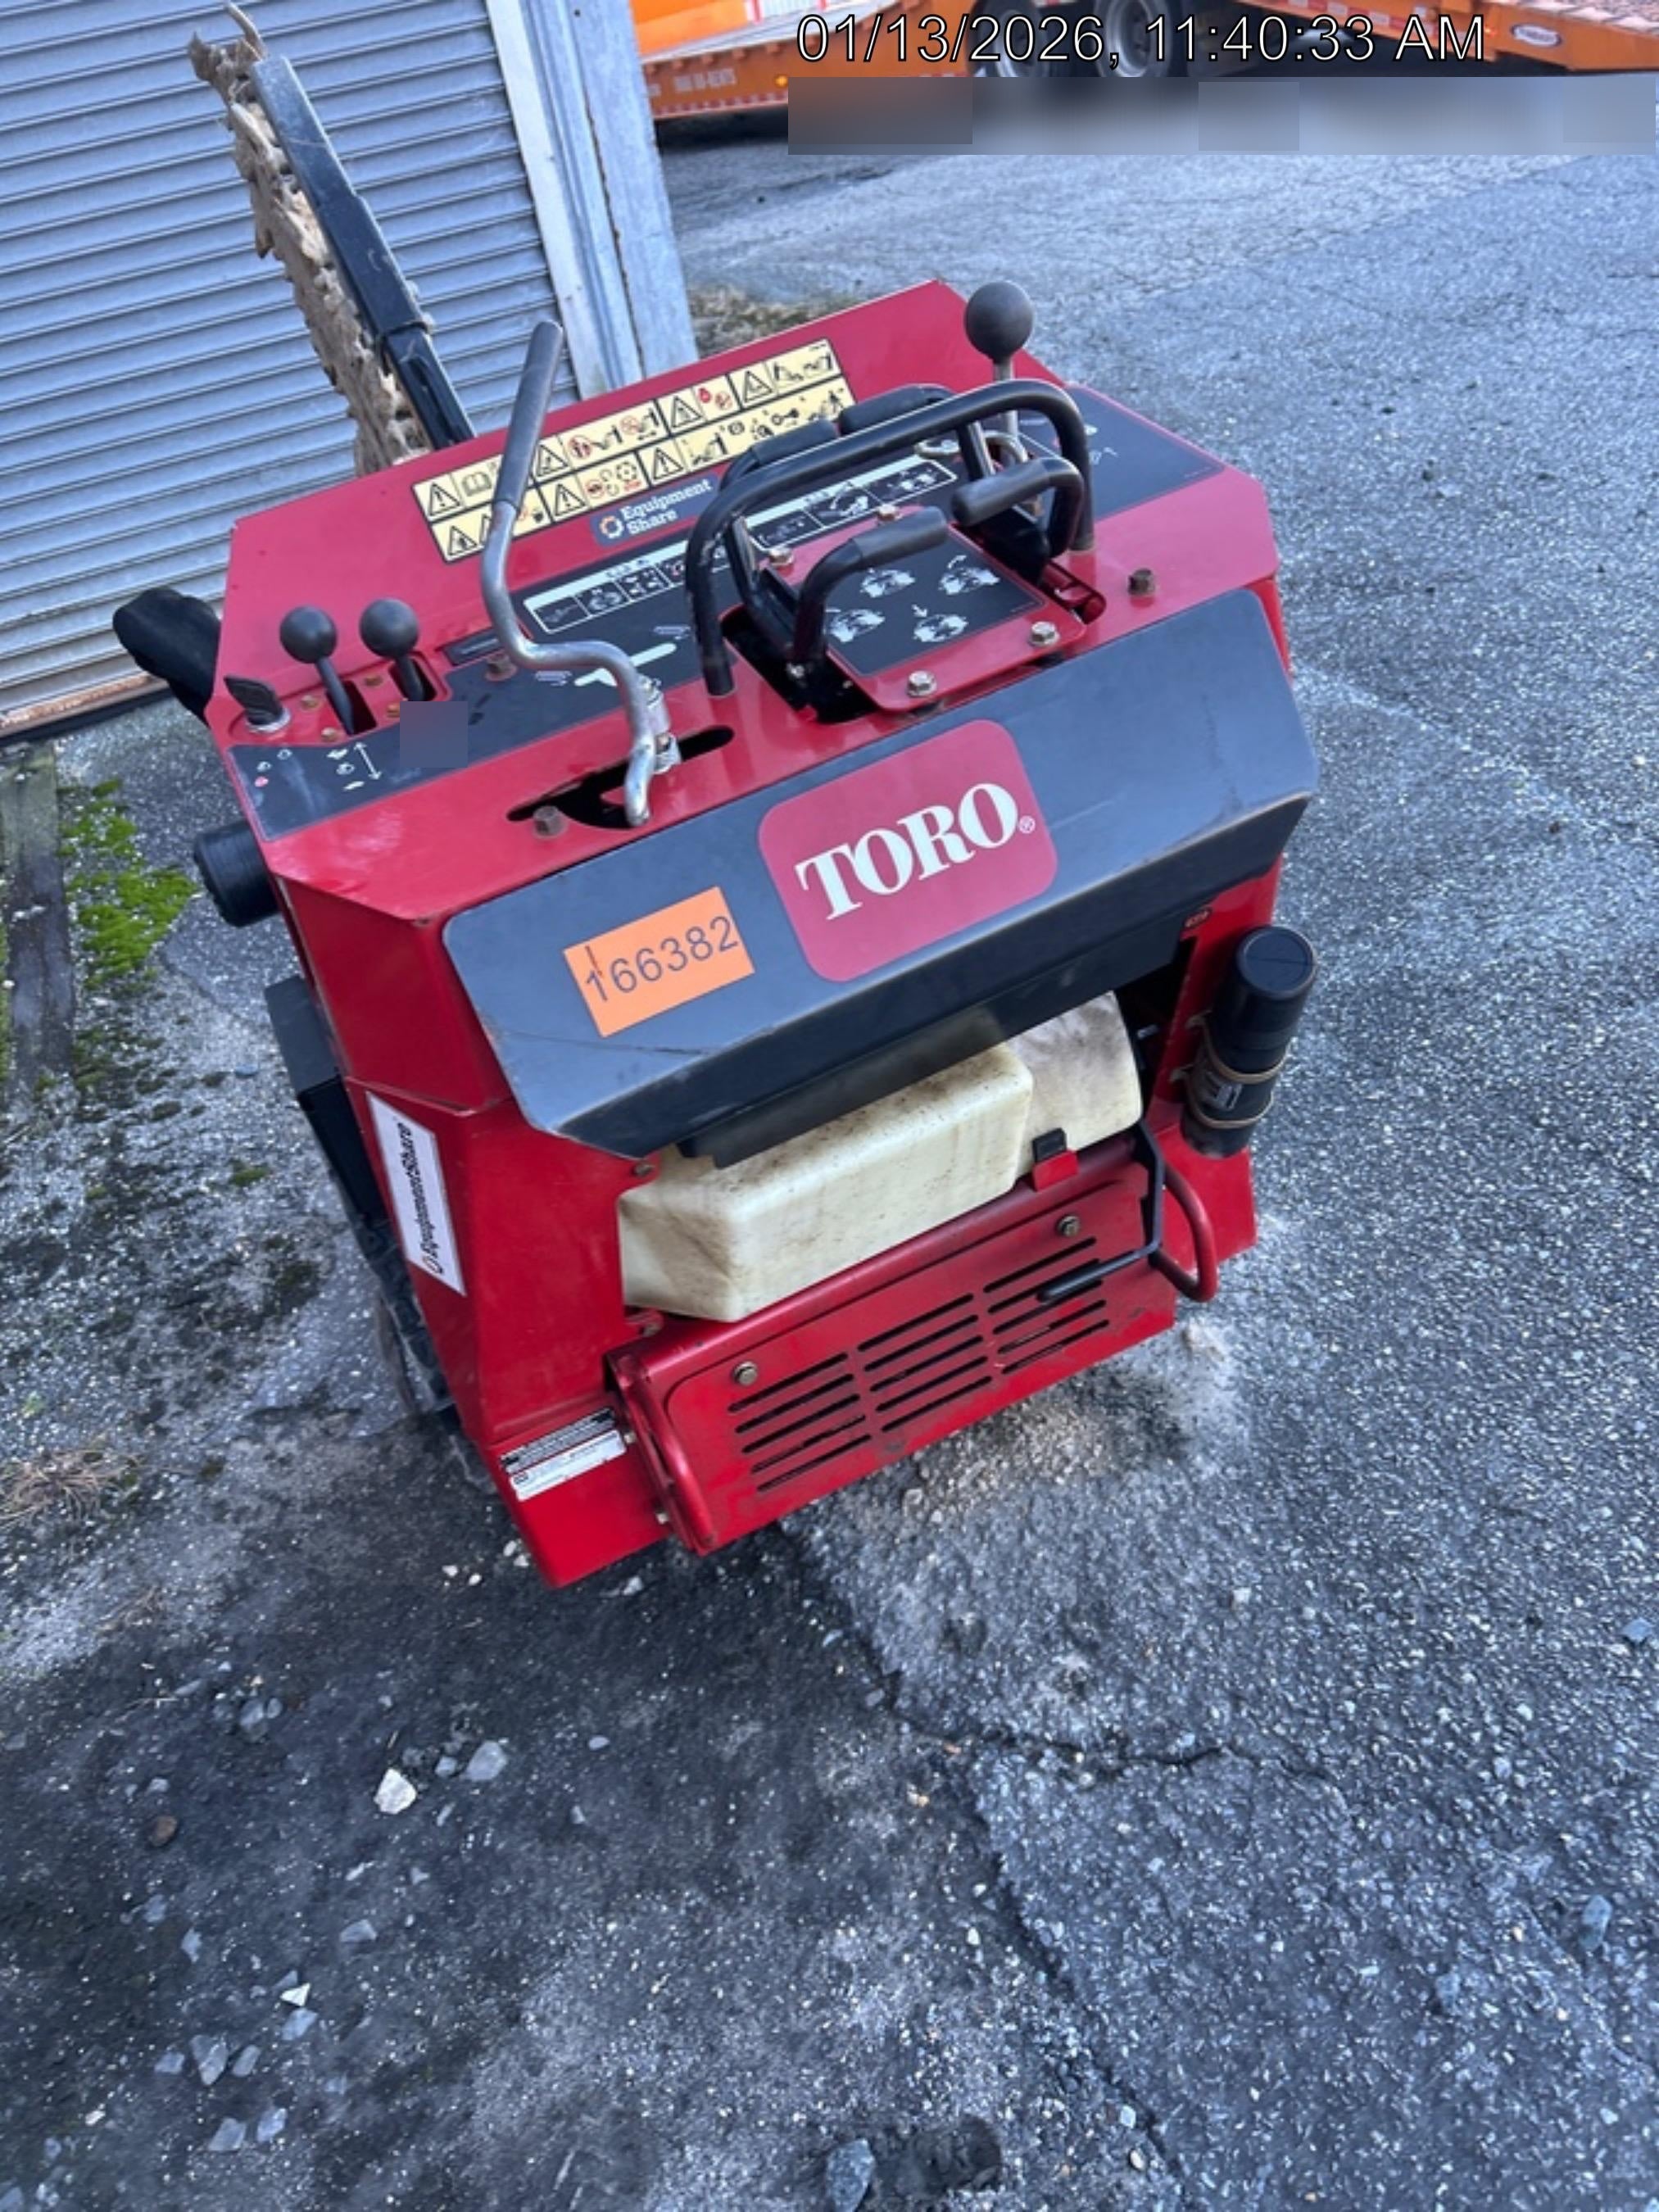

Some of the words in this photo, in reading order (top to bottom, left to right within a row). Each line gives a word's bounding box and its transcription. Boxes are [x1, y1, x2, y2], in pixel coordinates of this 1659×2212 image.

[620, 478, 712, 520] Equipment
[627, 508, 678, 534] Share
[585, 915, 738, 1002] 166382
